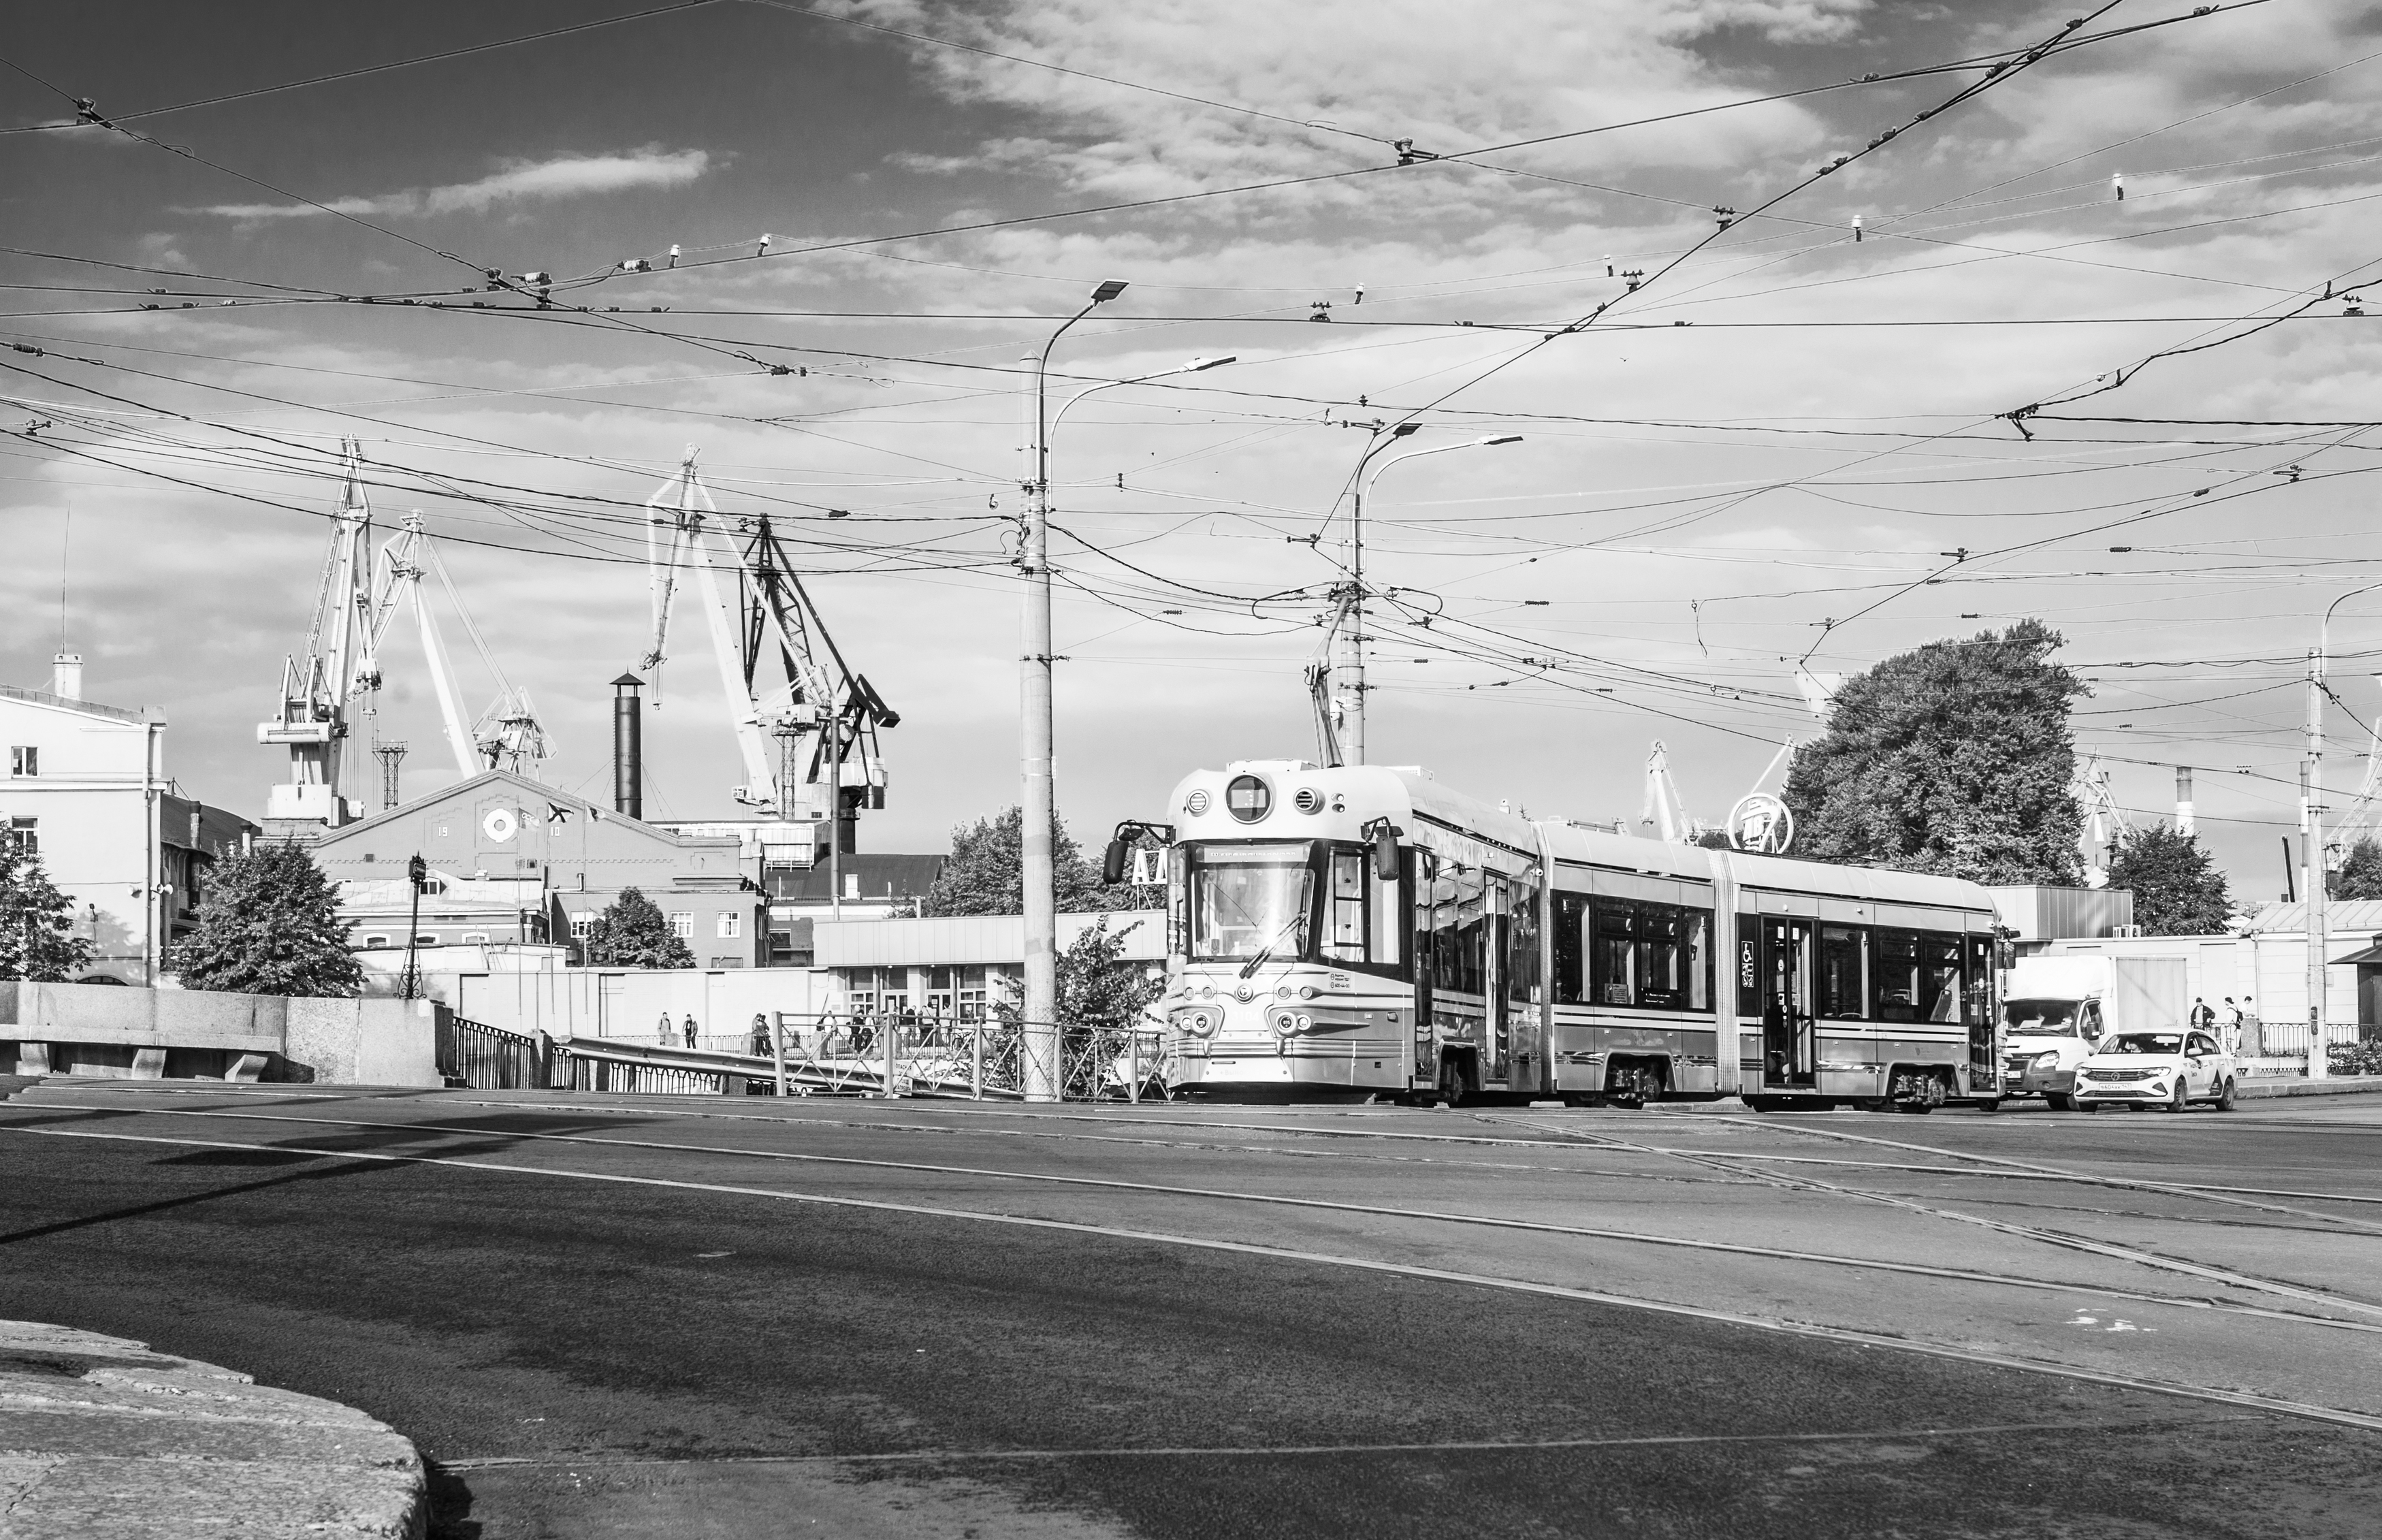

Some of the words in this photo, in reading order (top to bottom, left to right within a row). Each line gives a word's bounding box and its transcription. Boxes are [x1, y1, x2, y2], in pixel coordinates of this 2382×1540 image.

[438, 826, 448, 837] 19
[551, 826, 560, 837] 10
[1232, 1011, 1259, 1022] 3104
[895, 1063, 912, 1071] ОПАСНЯ
